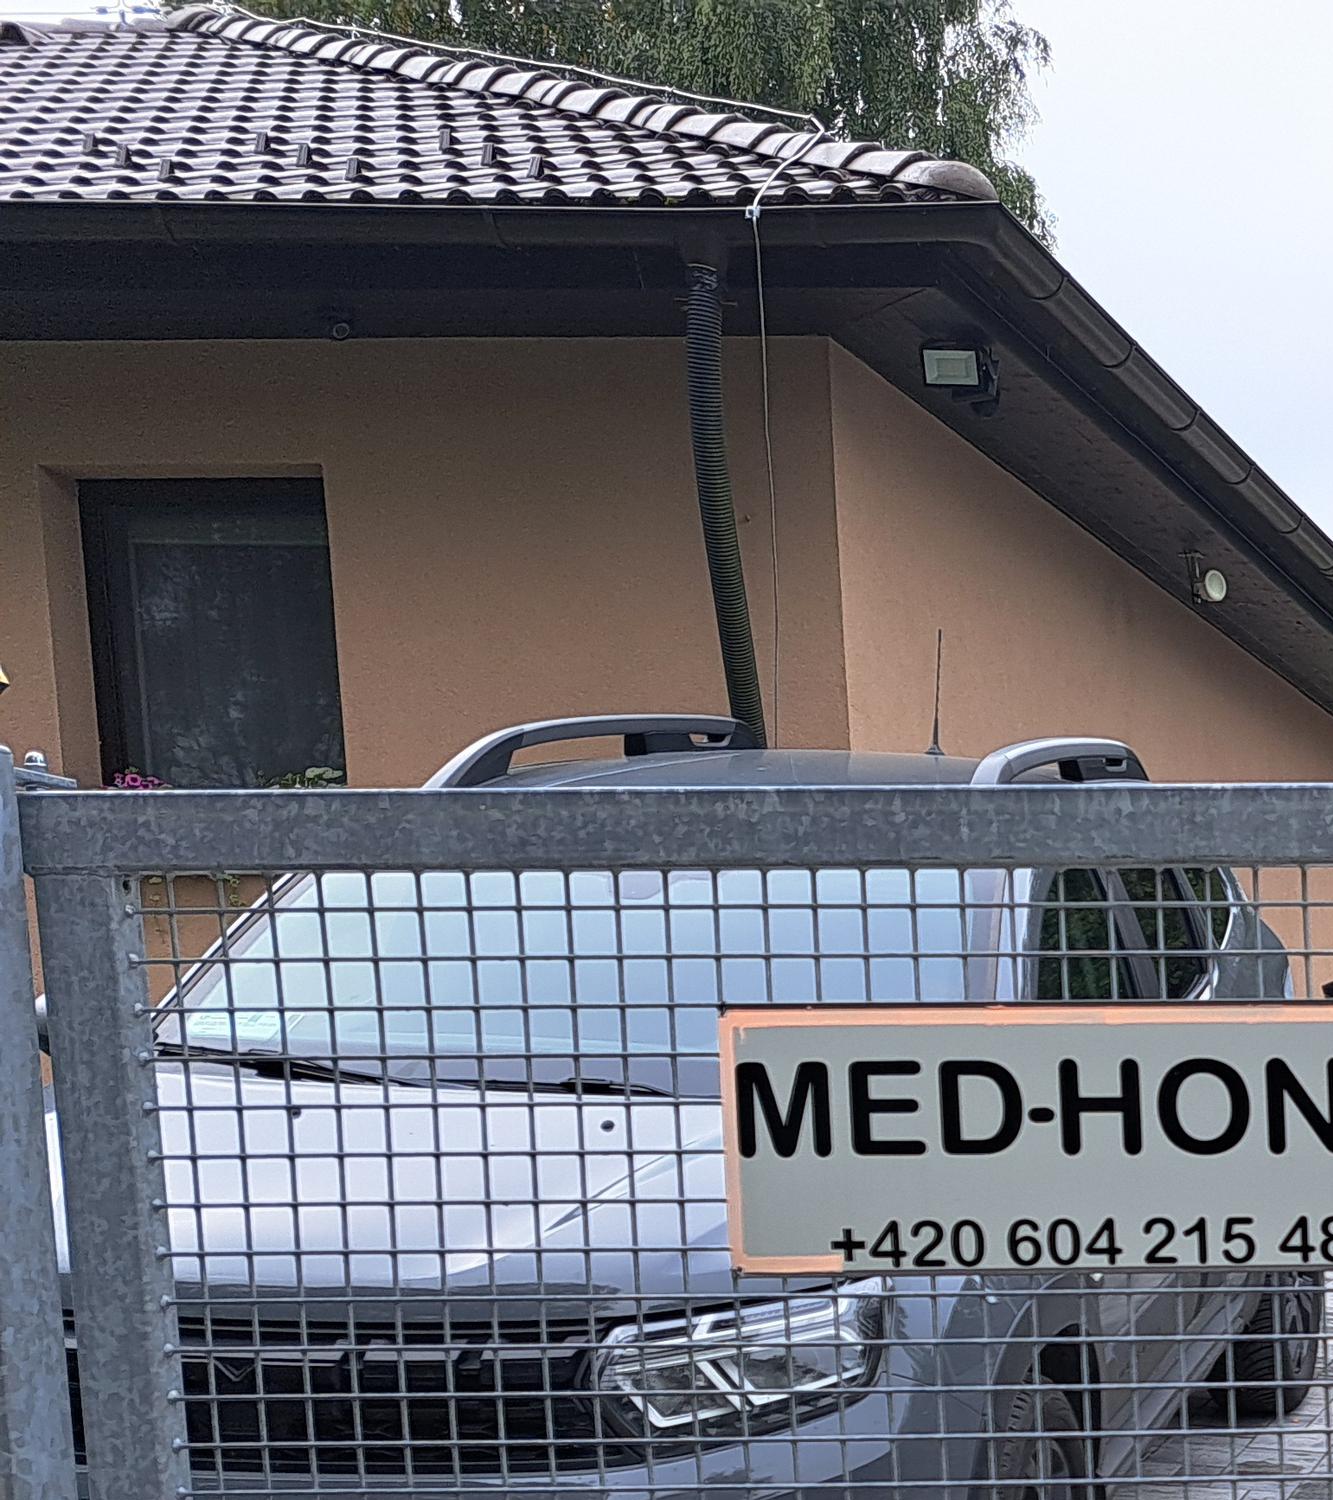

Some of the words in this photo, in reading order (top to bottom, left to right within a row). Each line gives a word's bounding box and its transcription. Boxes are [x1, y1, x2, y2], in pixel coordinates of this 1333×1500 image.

[831, 1219, 985, 1268] +420
[1007, 1217, 1122, 1266] 604
[1143, 1216, 1256, 1264] 215
